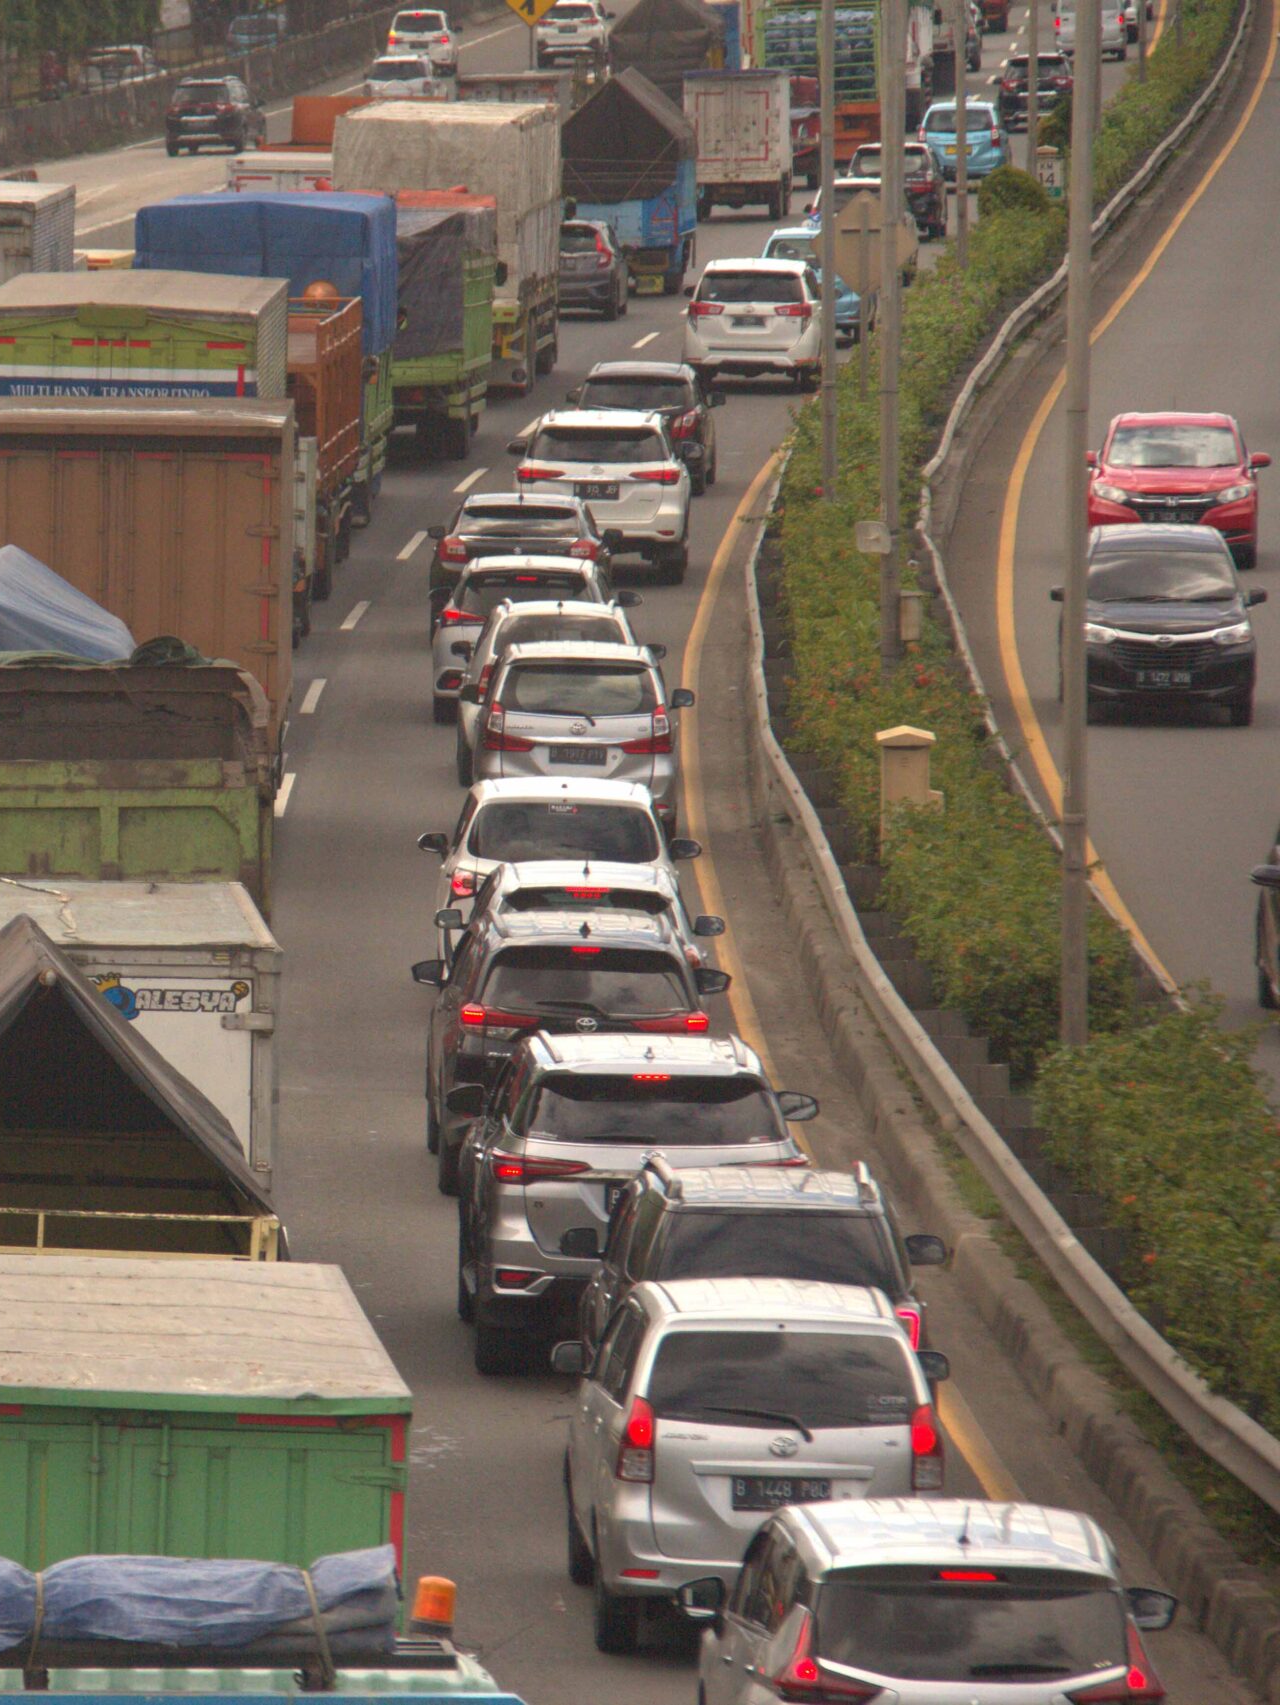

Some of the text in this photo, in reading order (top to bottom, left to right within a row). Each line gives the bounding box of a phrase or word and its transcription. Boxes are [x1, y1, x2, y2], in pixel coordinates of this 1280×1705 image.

[1038, 171, 1055, 186] 14
[736, 1479, 746, 1497] B
[756, 1480, 793, 1498] 1448
